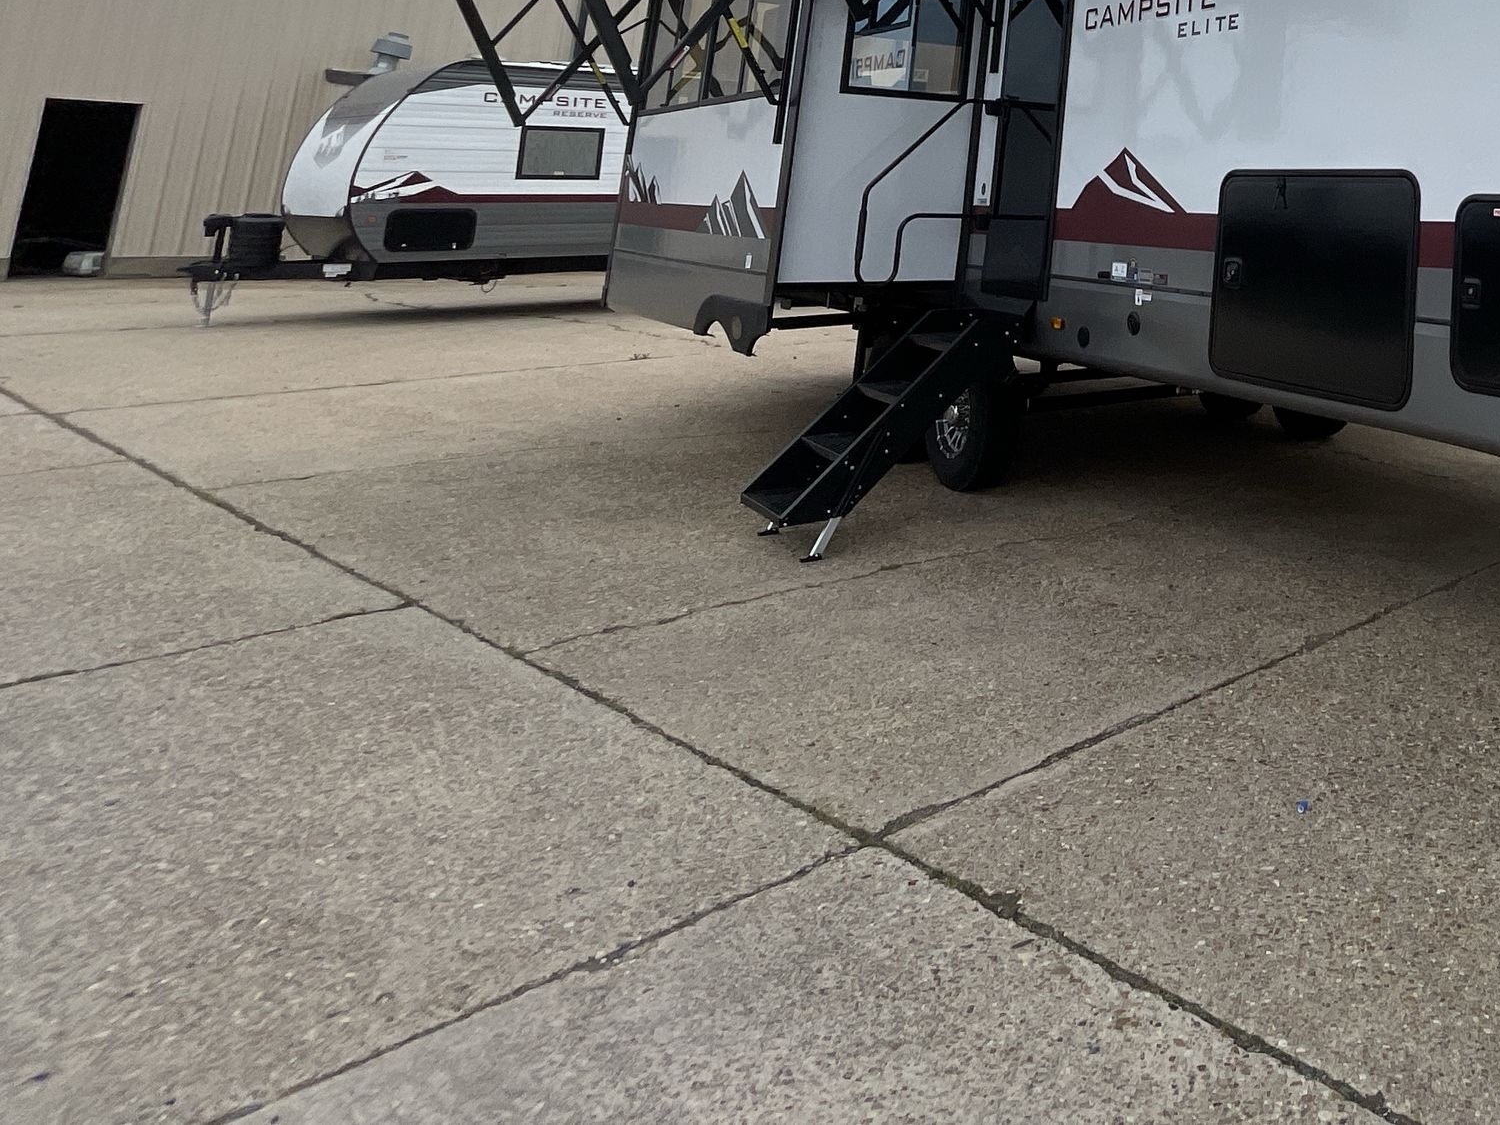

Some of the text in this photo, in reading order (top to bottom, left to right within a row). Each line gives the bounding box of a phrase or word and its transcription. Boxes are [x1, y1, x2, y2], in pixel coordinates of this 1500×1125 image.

[1177, 13, 1240, 39] ELITE
[484, 92, 607, 109] CMSITE
[553, 109, 607, 119] RESERVE
